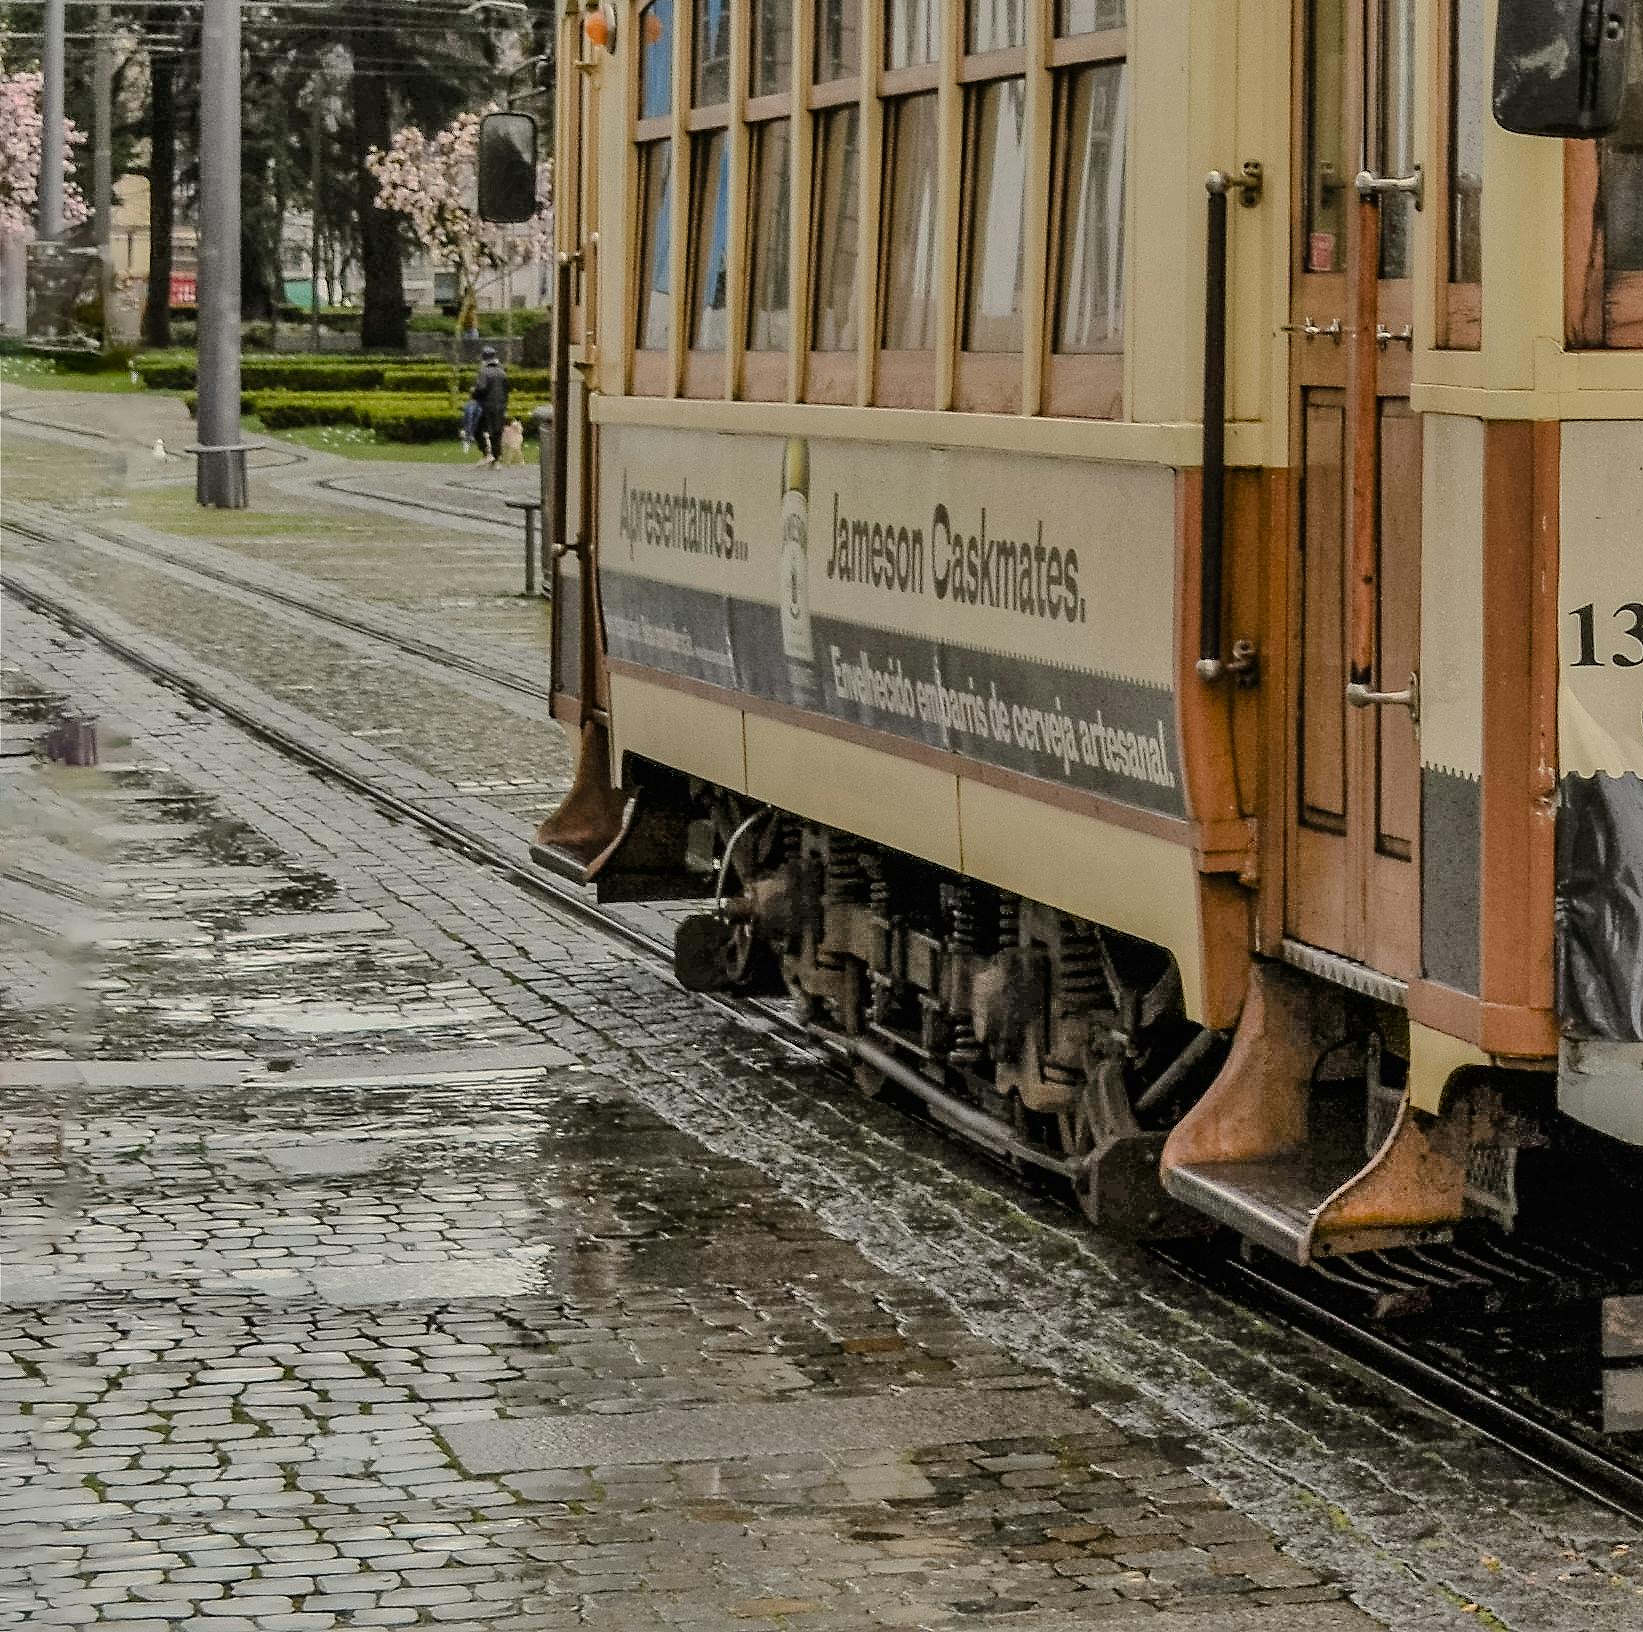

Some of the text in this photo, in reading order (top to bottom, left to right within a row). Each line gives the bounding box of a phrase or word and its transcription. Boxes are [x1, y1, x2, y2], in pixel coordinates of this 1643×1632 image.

[620, 469, 749, 562] Apresentamos...
[827, 493, 1087, 624] Jameson Caskmates.
[1012, 695, 1081, 776] cerveja
